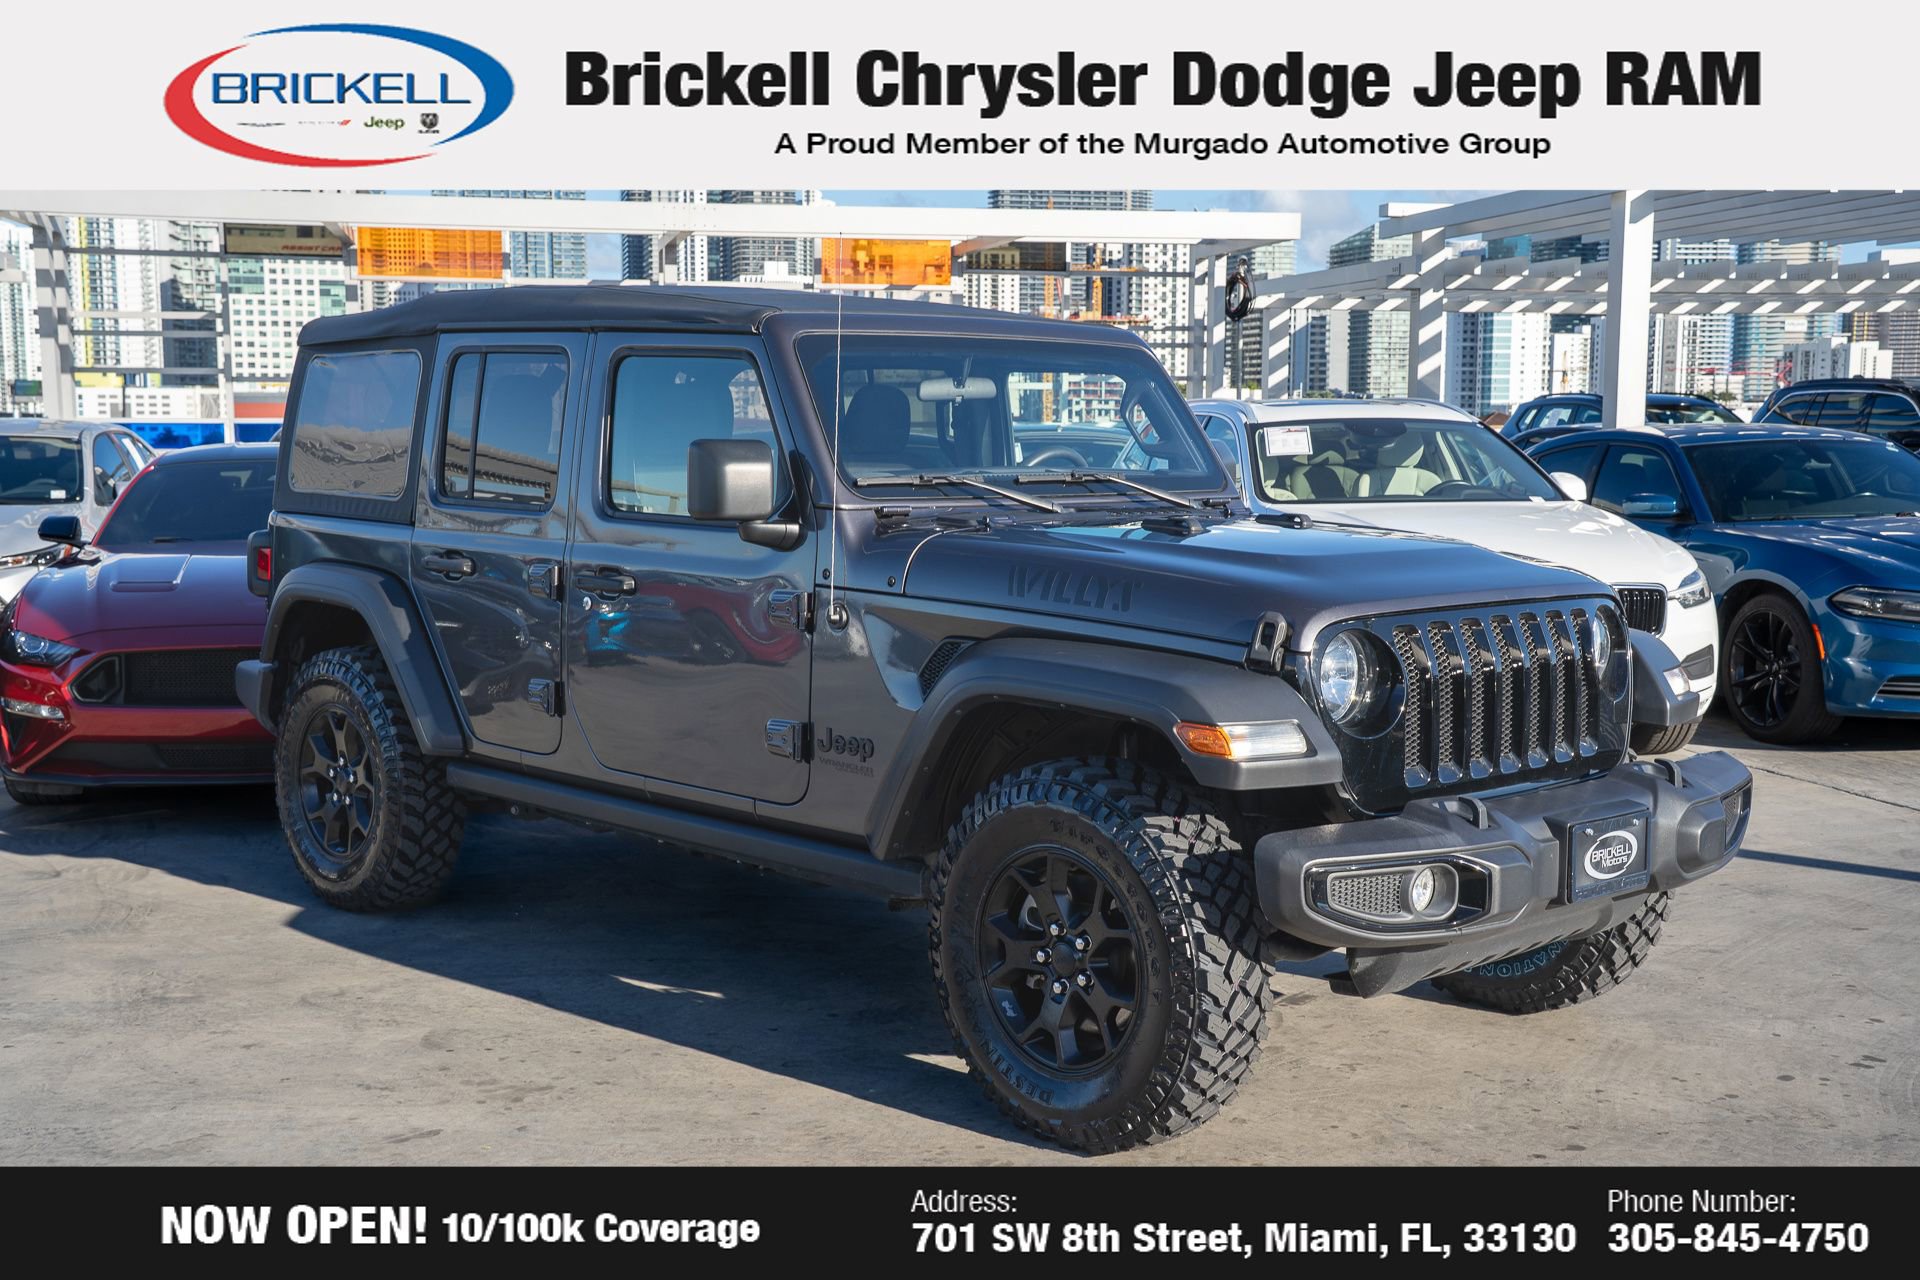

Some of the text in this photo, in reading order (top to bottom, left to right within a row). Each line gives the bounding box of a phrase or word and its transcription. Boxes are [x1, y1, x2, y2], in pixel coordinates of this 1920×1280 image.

[817, 727, 875, 763] Jeep
[1591, 843, 1632, 863] BRICKELL
[1601, 855, 1628, 868] Motors
